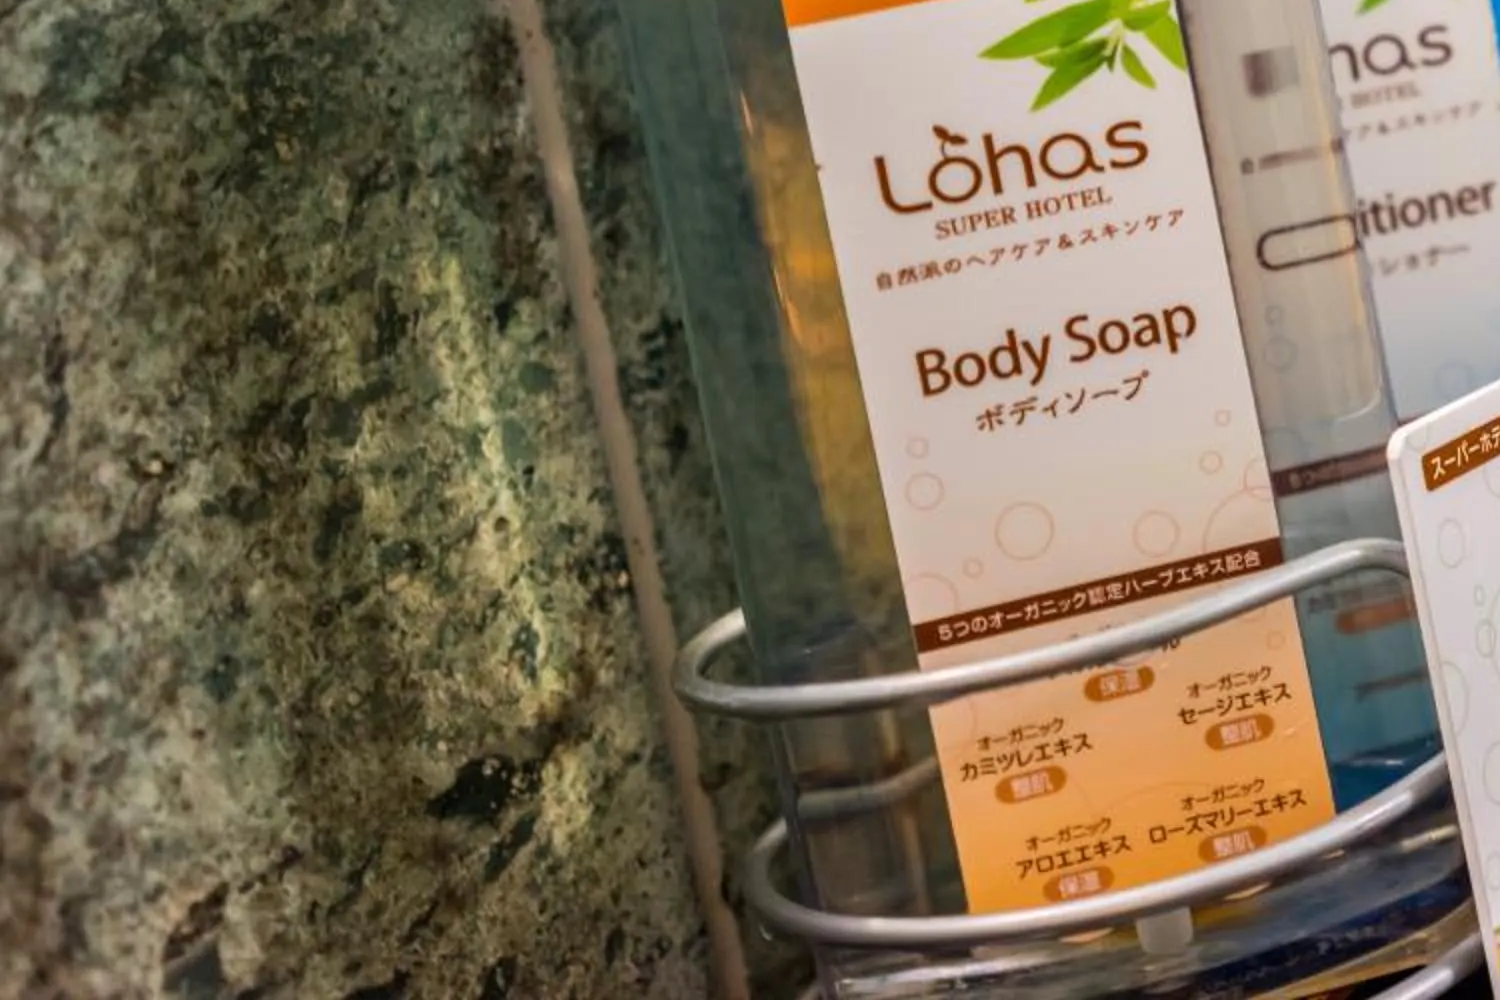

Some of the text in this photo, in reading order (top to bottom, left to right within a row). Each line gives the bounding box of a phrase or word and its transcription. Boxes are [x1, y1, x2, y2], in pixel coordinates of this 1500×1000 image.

[934, 186, 1113, 241] SUPER HOTEL
[1355, 180, 1497, 238] itioner
[914, 304, 1197, 398] Body Soap
[975, 369, 1150, 432] ボディソープ
[1177, 682, 1293, 725] セージエキス
[1186, 665, 1272, 698] オーガニック
[959, 732, 1094, 783] カミツレエキス
[976, 716, 1066, 751] オーガニック
[1149, 788, 1308, 846] ローズマリーエキス
[1181, 777, 1265, 811] オーガニック
[1016, 834, 1132, 880] アロエエキス
[1025, 816, 1112, 852] オーガニック
